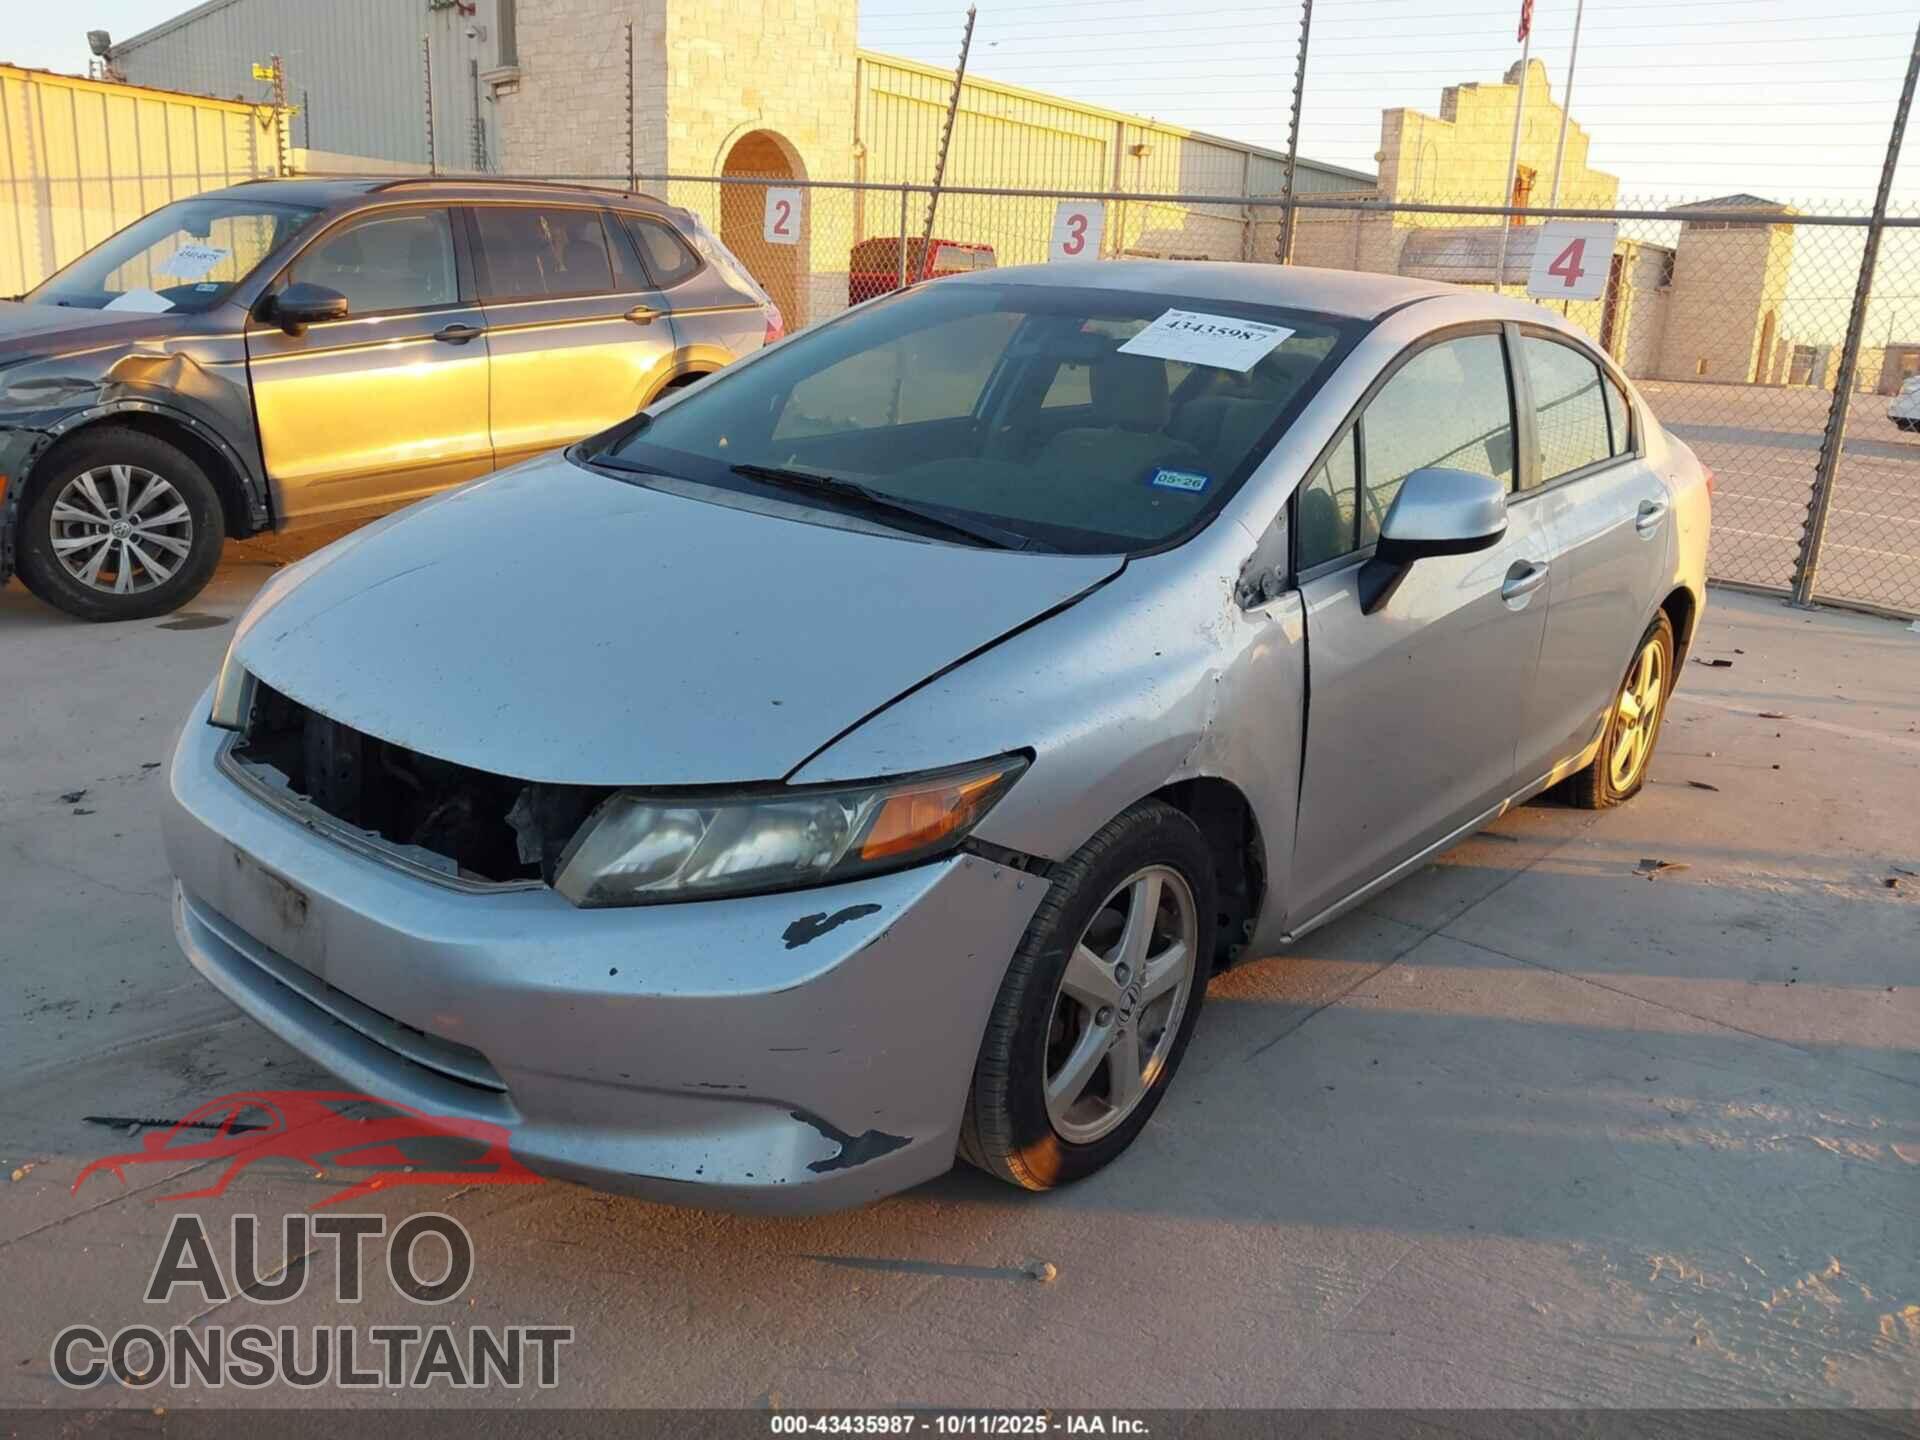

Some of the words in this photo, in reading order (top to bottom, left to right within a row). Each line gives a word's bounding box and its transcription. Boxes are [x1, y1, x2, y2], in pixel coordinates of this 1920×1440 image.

[773, 200, 791, 235] 2
[1063, 214, 1089, 255] 3
[1548, 238, 1586, 287] 4
